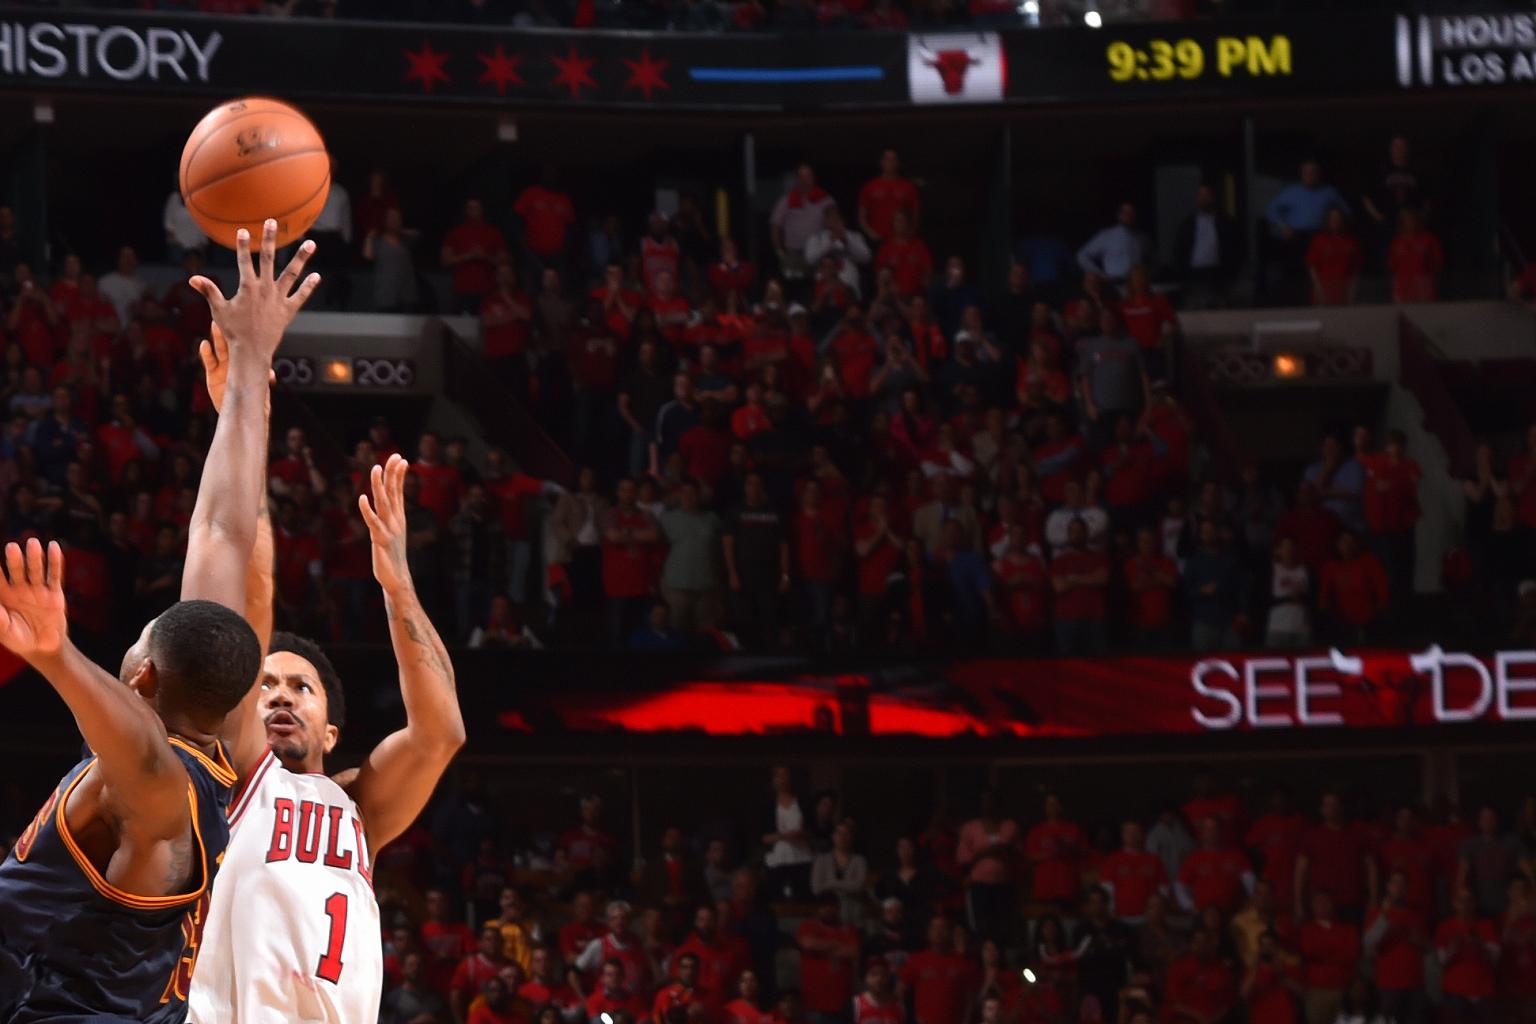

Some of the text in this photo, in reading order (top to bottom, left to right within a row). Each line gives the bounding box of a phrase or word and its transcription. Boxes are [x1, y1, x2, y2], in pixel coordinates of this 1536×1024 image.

[1107, 34, 1292, 81] 9:39 PM
[1442, 53, 1505, 85] LOS
[356, 359, 412, 386] 206
[1191, 651, 1536, 729] SEE DE
[315, 891, 349, 986] 1
